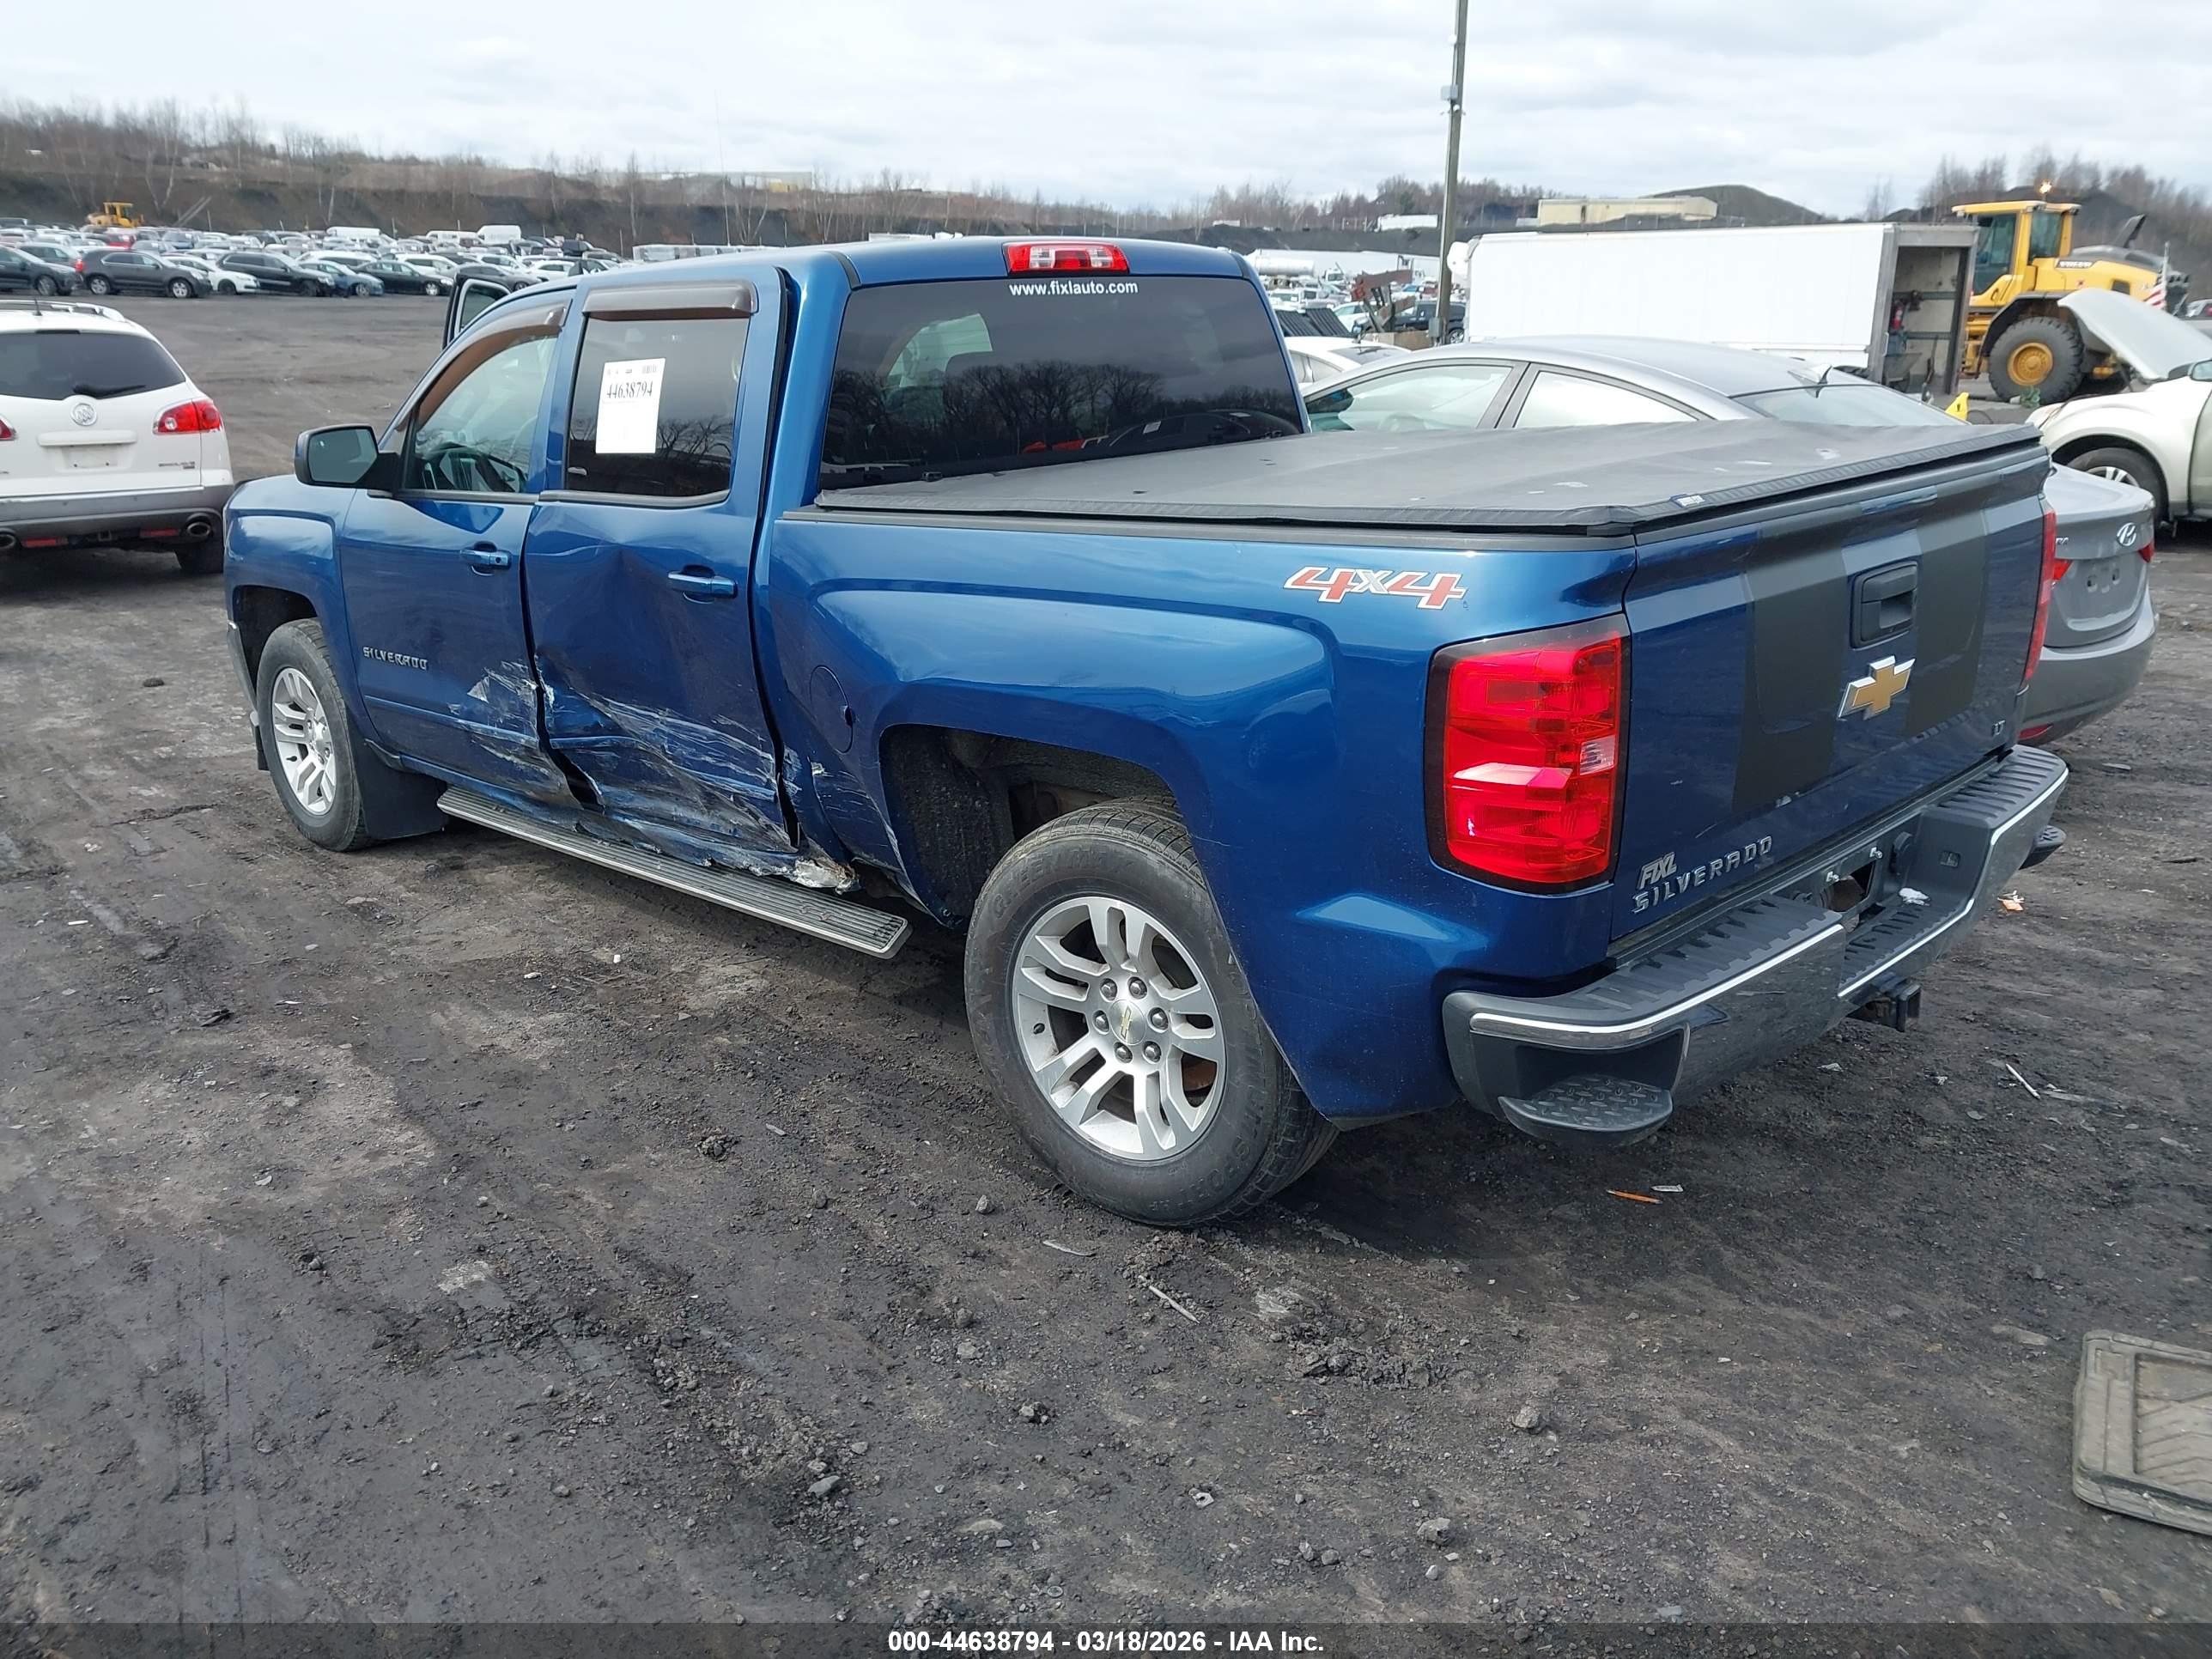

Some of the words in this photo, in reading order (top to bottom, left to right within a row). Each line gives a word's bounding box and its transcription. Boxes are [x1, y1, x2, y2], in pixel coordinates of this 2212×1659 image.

[1009, 280, 1138, 296] www.fixlauto.com
[606, 380, 653, 399] 44638794
[363, 647, 428, 670] SILVERADO
[1632, 836, 1772, 914] SILVERADO
